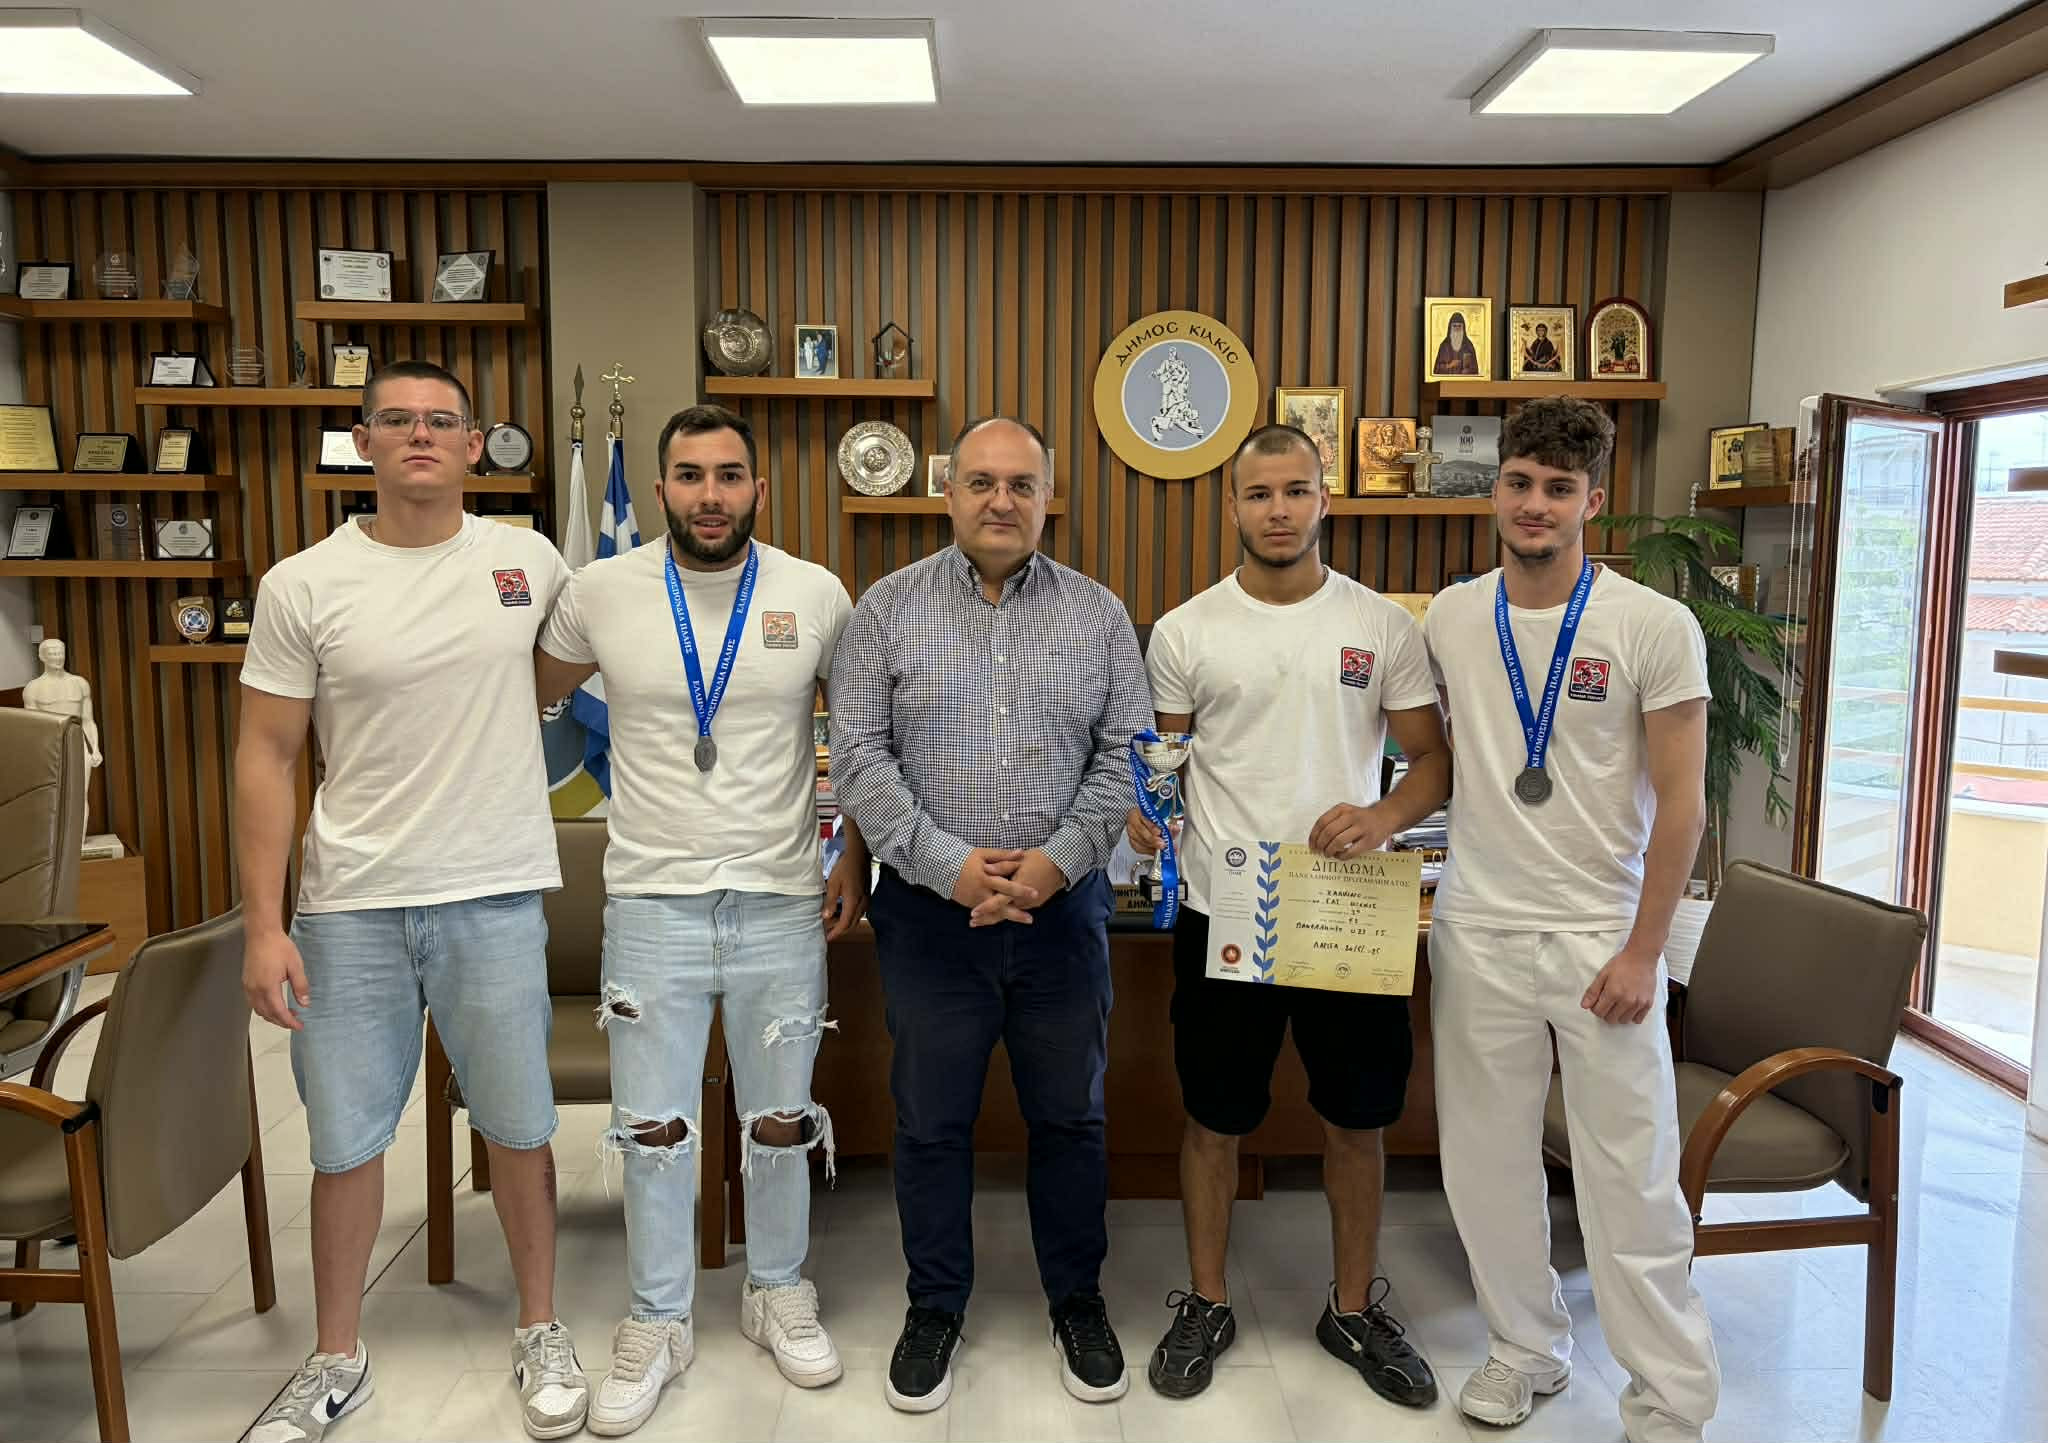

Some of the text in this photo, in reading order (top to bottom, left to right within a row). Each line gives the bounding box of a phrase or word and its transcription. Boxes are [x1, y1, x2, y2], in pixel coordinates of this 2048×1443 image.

[1565, 582, 1588, 629] ΕΛΛΗΝΙΚΗ
[679, 622, 693, 655] ΠΑΛΗΣ
[720, 638, 736, 671] ΠΑΛΗΣ
[1509, 668, 1524, 700] ΠΑΛΗΣ
[1534, 690, 1555, 753] ΟΜΟΣΠΟΝΔΙΑ
[1549, 656, 1565, 690] ΠΑΛΗΣ
[1311, 859, 1386, 877] ΔΙΠΛΩΜΑ
